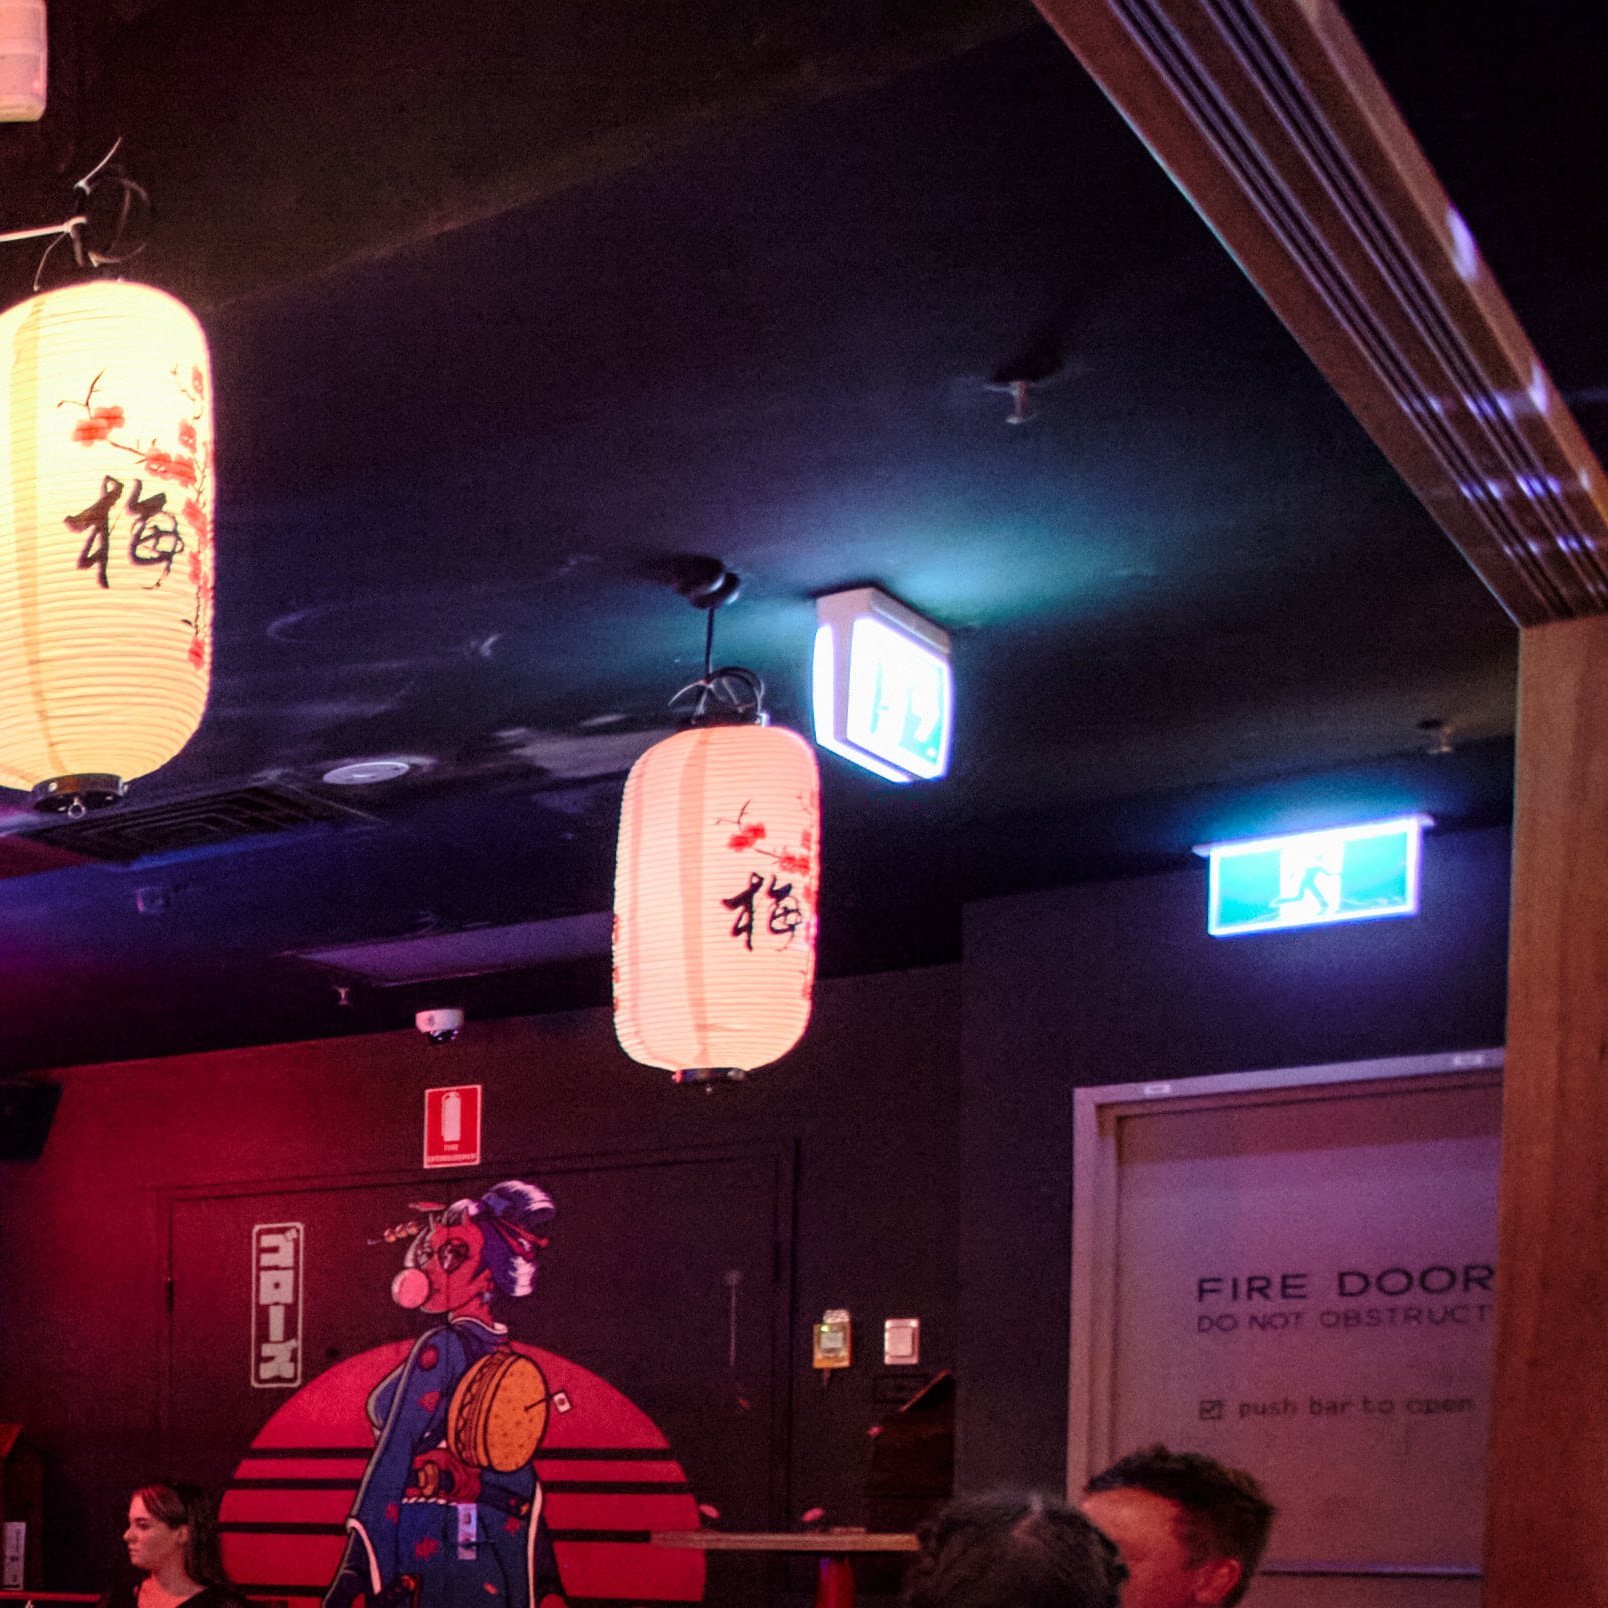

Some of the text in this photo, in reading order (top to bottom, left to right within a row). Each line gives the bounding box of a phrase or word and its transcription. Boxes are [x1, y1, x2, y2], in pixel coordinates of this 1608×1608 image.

[1198, 1264, 1494, 1301] FIRE DOOR
[1197, 1303, 1494, 1333] DO NOT OBSTRUCT
[1239, 1397, 1473, 1418] push bar to open
